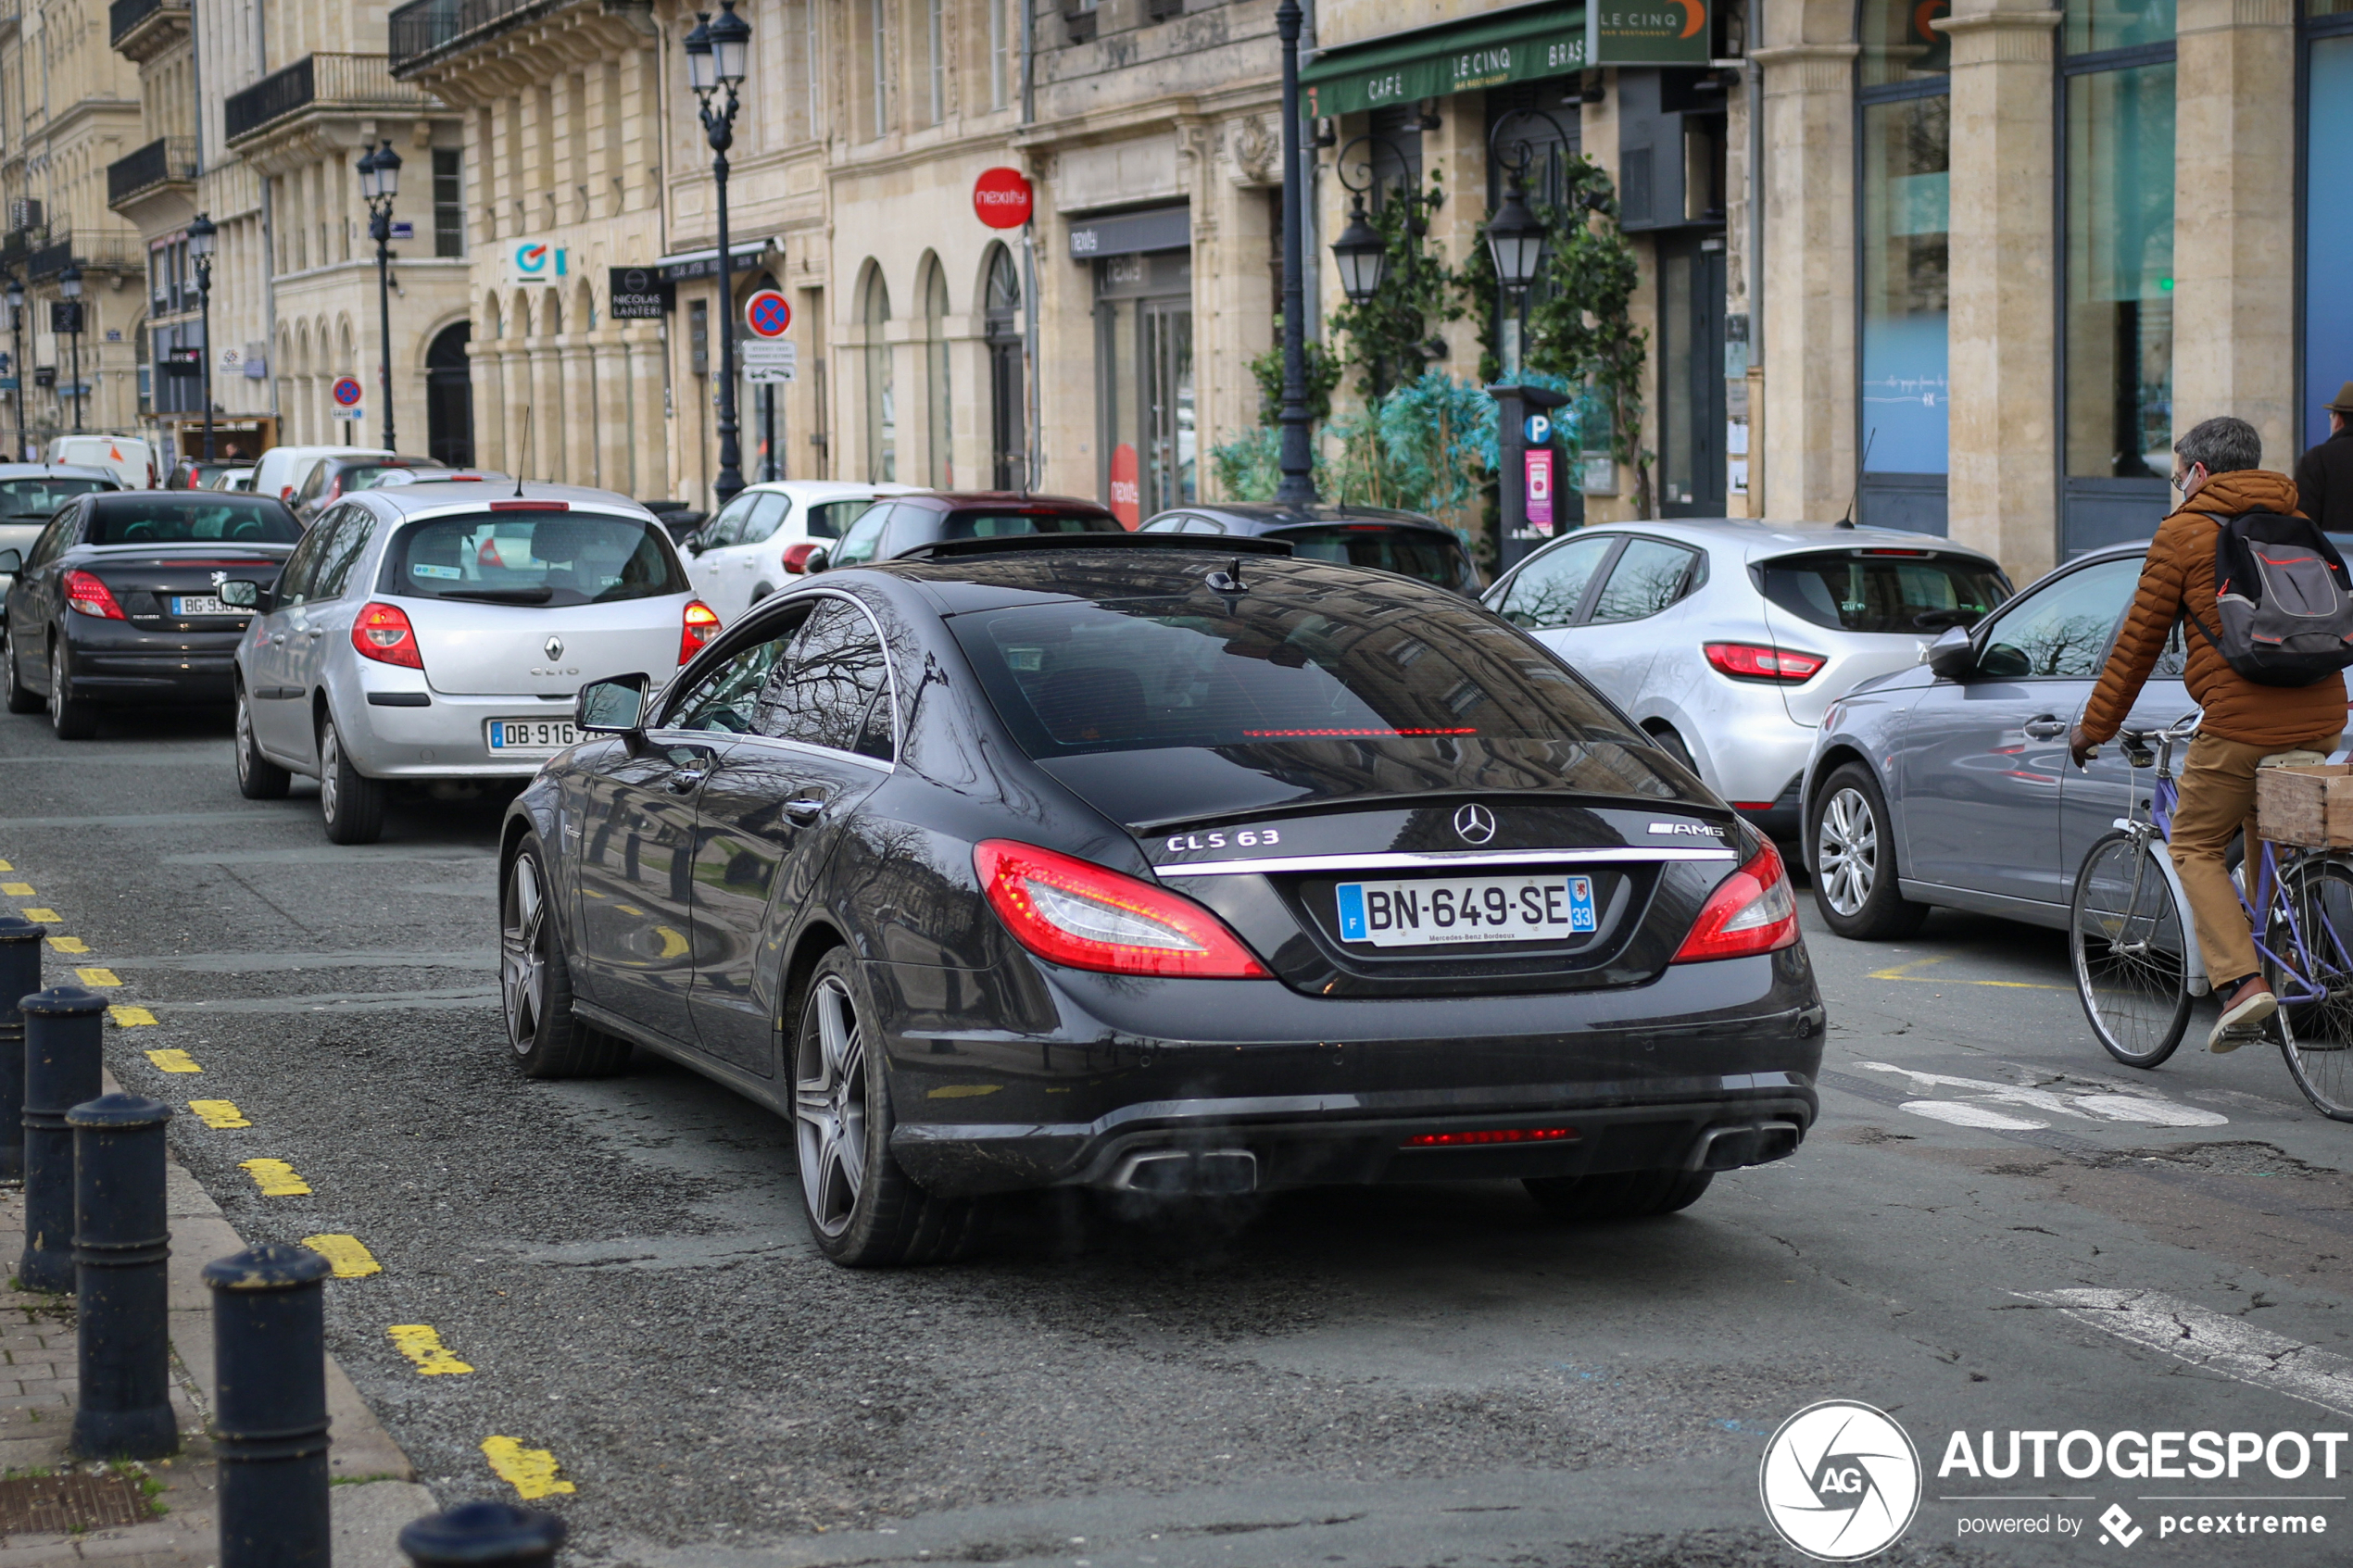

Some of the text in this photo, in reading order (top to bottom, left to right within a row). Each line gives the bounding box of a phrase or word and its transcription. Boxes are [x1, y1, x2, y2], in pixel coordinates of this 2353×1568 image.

[1600, 13, 1677, 26] LE CINQ
[1453, 47, 1511, 78] LE CINQ
[1548, 40, 1587, 68] BRAS
[976, 190, 1026, 206] nexity
[1071, 230, 1098, 251] nexity
[613, 295, 661, 306] NICOLAS
[613, 306, 661, 317] LANTERI
[1531, 415, 1549, 443] P
[1112, 480, 1139, 505] nexity
[530, 667, 579, 676] CLIO
[1673, 825, 1725, 837] AMG
[1166, 830, 1280, 852] CLS 63
[1366, 885, 1568, 930] BN-649-SE
[1349, 918, 1356, 929] F
[1572, 908, 1591, 926] 33
